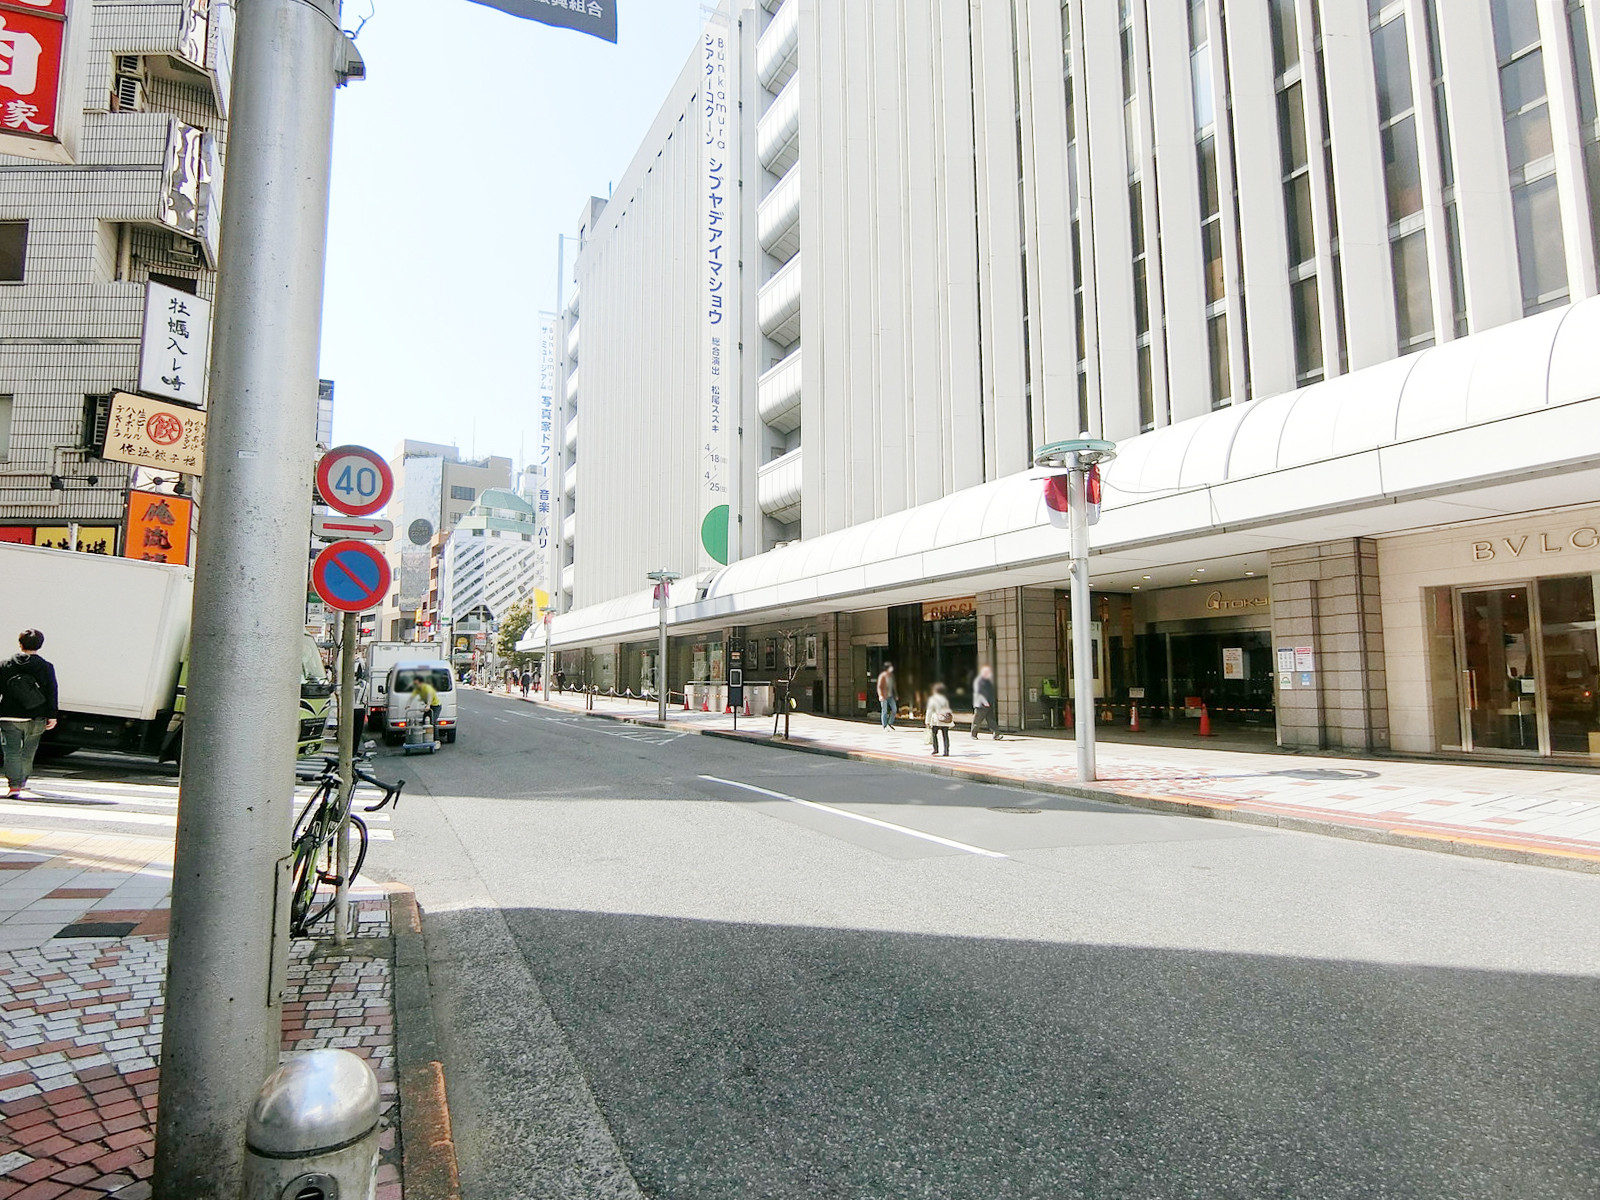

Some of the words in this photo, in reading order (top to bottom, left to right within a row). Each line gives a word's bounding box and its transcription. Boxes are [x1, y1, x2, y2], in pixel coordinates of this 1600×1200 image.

[705, 33, 714, 145] シアターコクーン
[716, 37, 727, 149] Bunkamura
[708, 157, 724, 325] シブヤデアイマショウ
[335, 465, 376, 497] 40
[1471, 527, 1600, 561] BVLG
